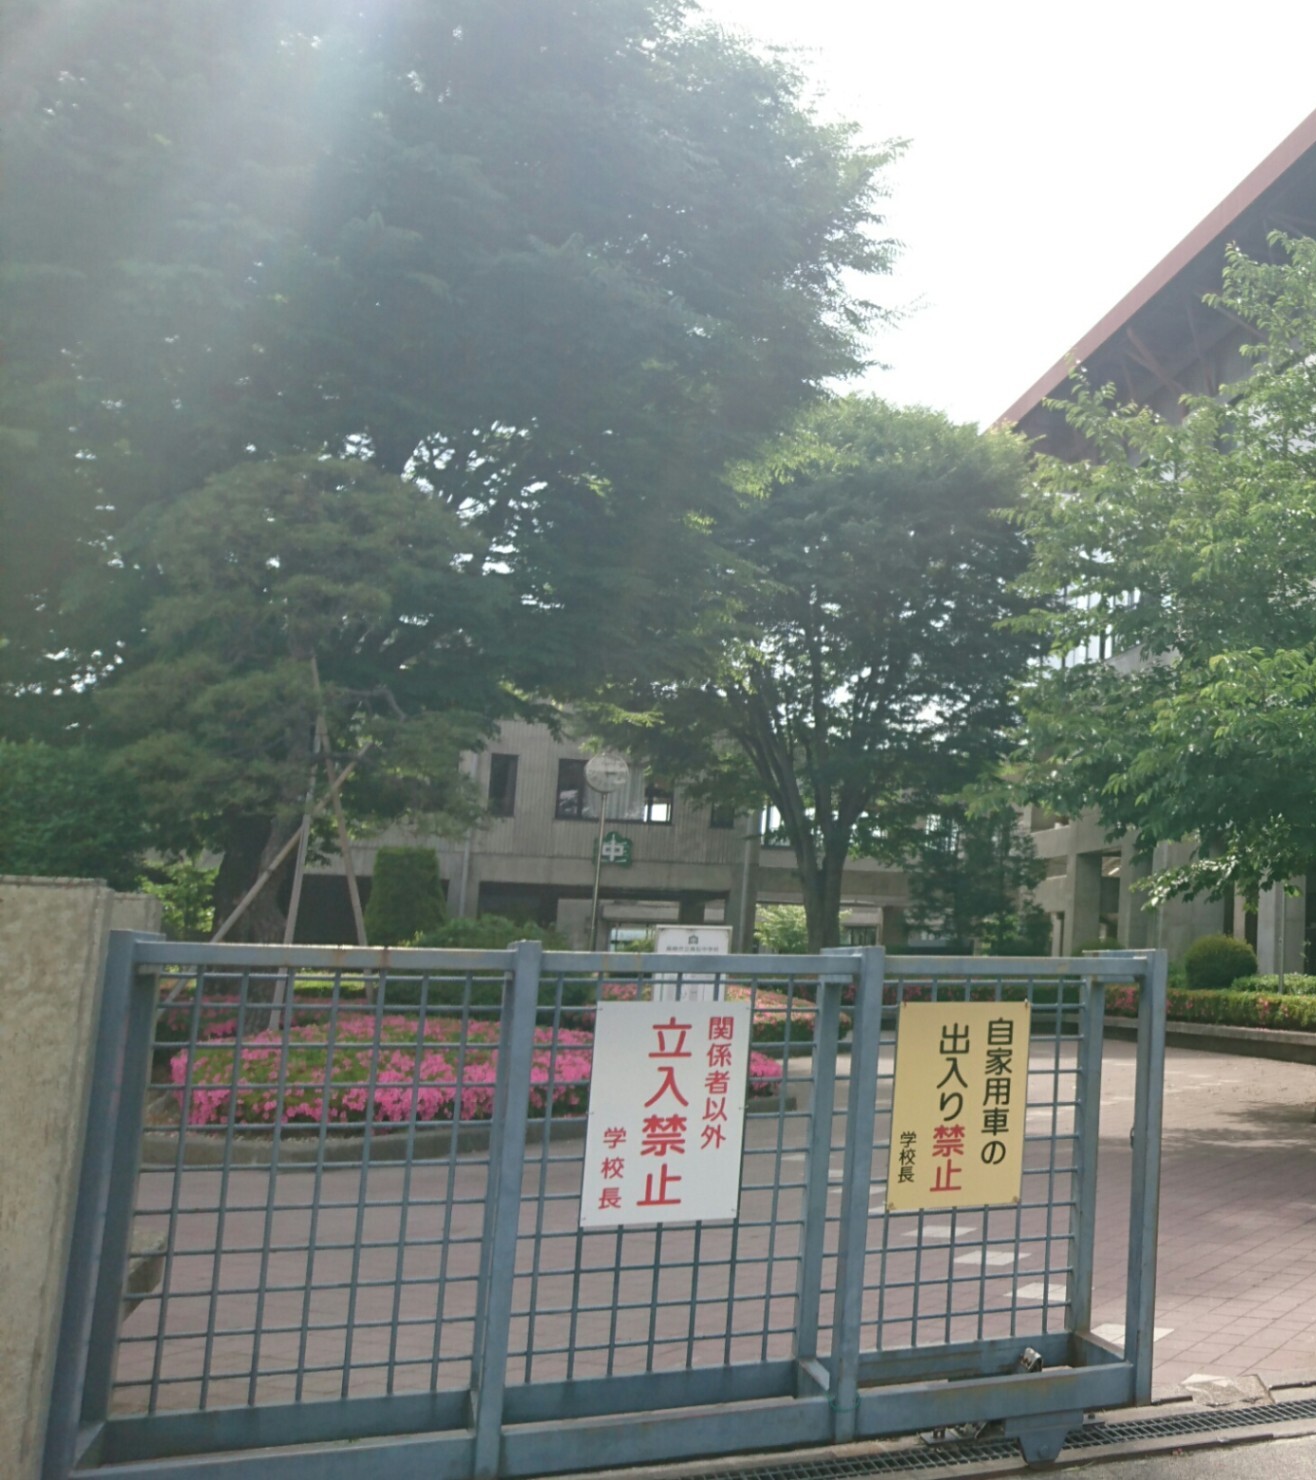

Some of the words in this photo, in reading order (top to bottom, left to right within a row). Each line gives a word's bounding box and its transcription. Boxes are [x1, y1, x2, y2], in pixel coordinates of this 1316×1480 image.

[636, 1016, 692, 1207] 立入禁止
[700, 1015, 734, 1150] 関係者以外
[929, 1022, 970, 1192] 出入り禁止
[980, 1017, 1014, 1166] 自家用車の
[598, 1126, 627, 1210] 学校長
[897, 1130, 917, 1183] 学校長
